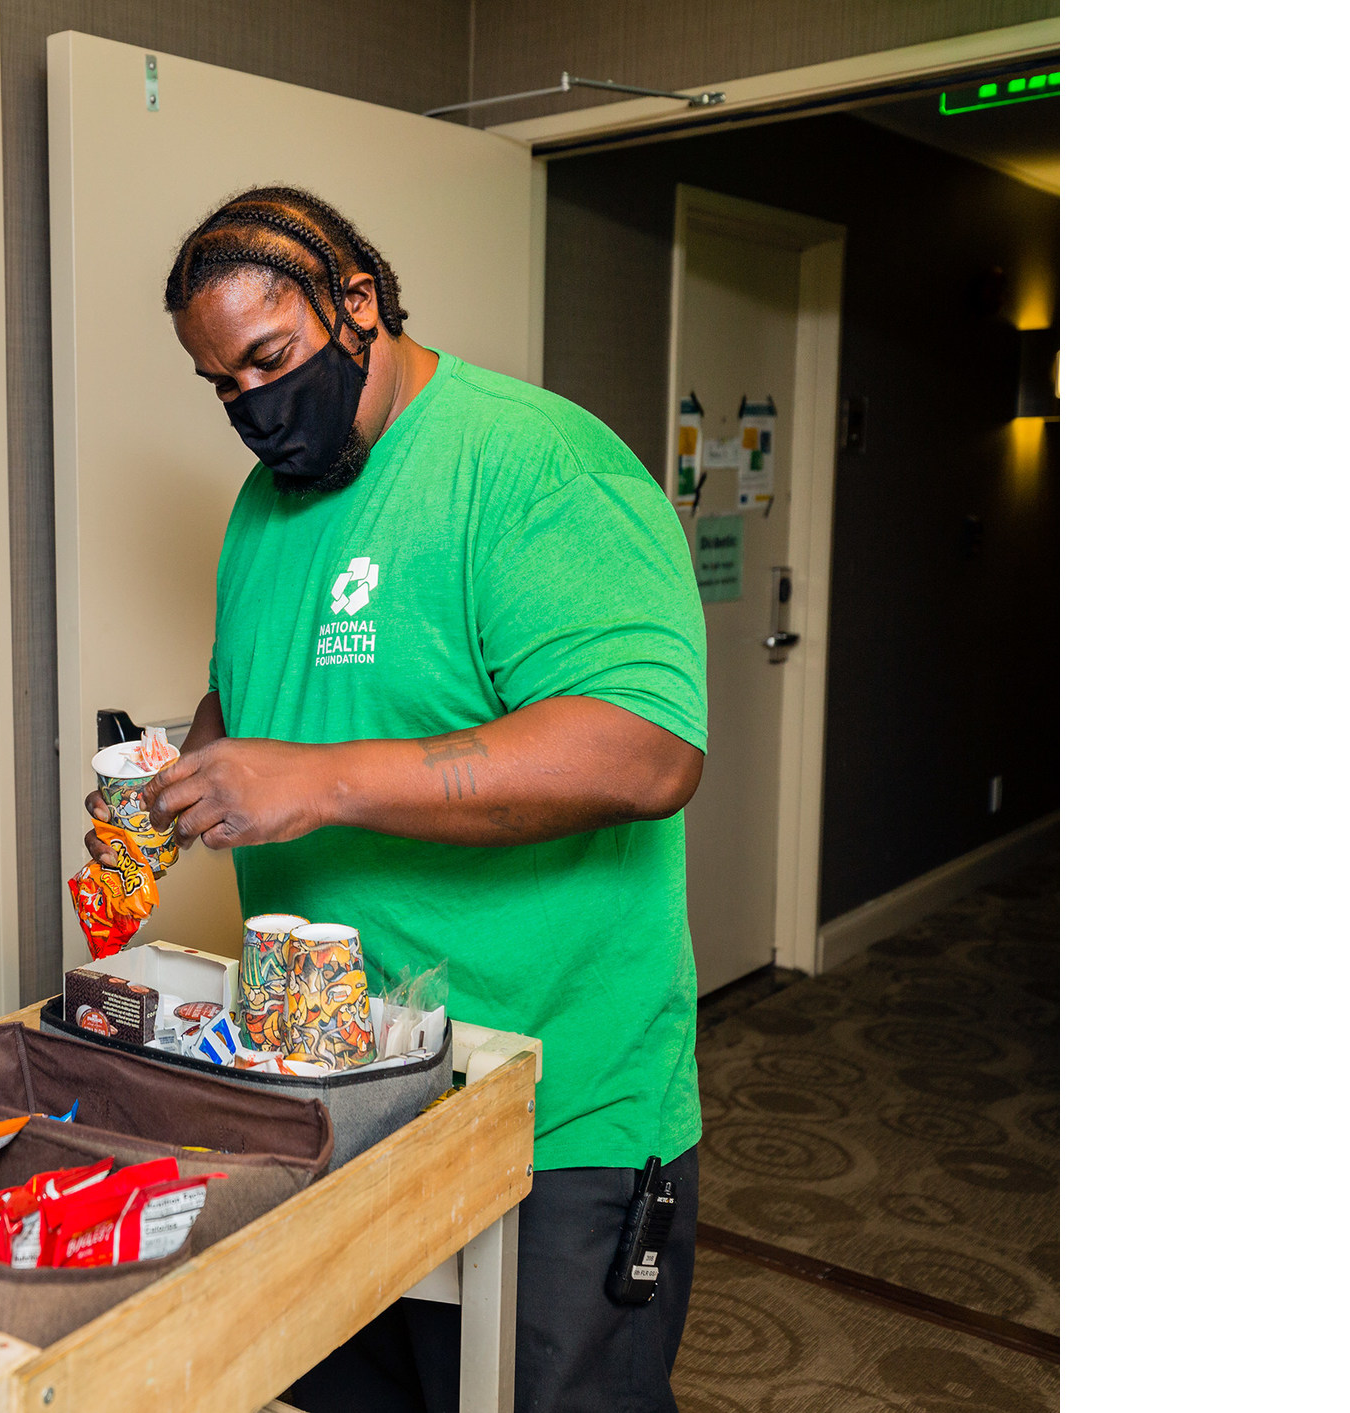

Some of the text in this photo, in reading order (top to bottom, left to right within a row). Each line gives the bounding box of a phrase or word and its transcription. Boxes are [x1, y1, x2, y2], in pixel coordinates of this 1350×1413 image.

[319, 620, 377, 637] NATIONAL
[316, 634, 376, 655] HEALTH
[315, 653, 375, 667] FOUNDATION
